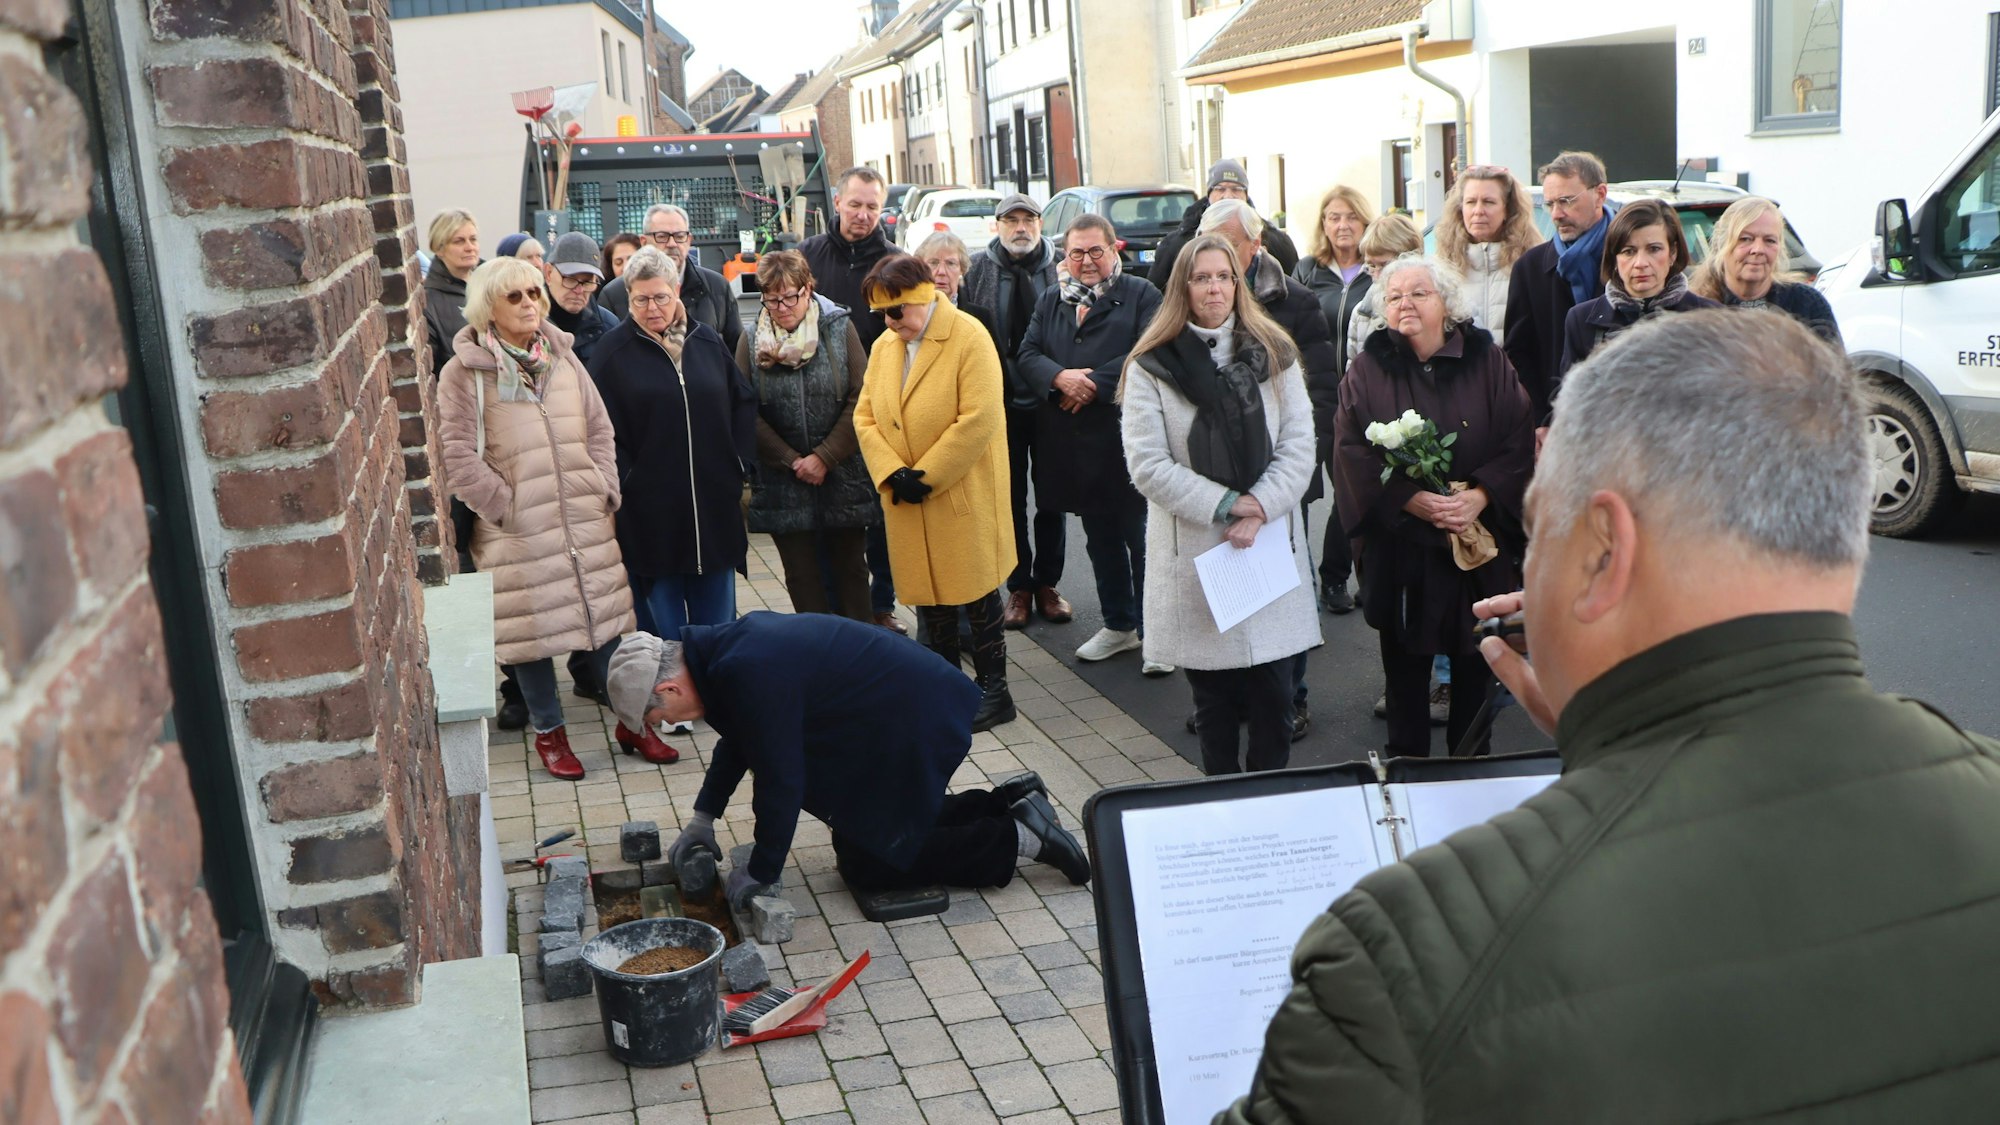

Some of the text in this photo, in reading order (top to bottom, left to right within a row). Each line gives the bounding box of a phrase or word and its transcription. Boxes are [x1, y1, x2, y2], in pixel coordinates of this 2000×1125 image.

[1689, 38, 1703, 54] 24
[1271, 849, 1288, 857] Frau
[1283, 858, 1294, 866] Ich
[1295, 855, 1309, 864] darf
[1322, 852, 1340, 860] daher
[1226, 893, 1244, 901] Stelle
[1246, 891, 1261, 899] auch
[1186, 955, 1200, 964] darf
[1251, 954, 1286, 965] Ansprache
[1188, 1051, 1228, 1062] Kurzvortrag
[1230, 1048, 1240, 1056] Dr.
[1202, 1071, 1220, 1080] Min)
